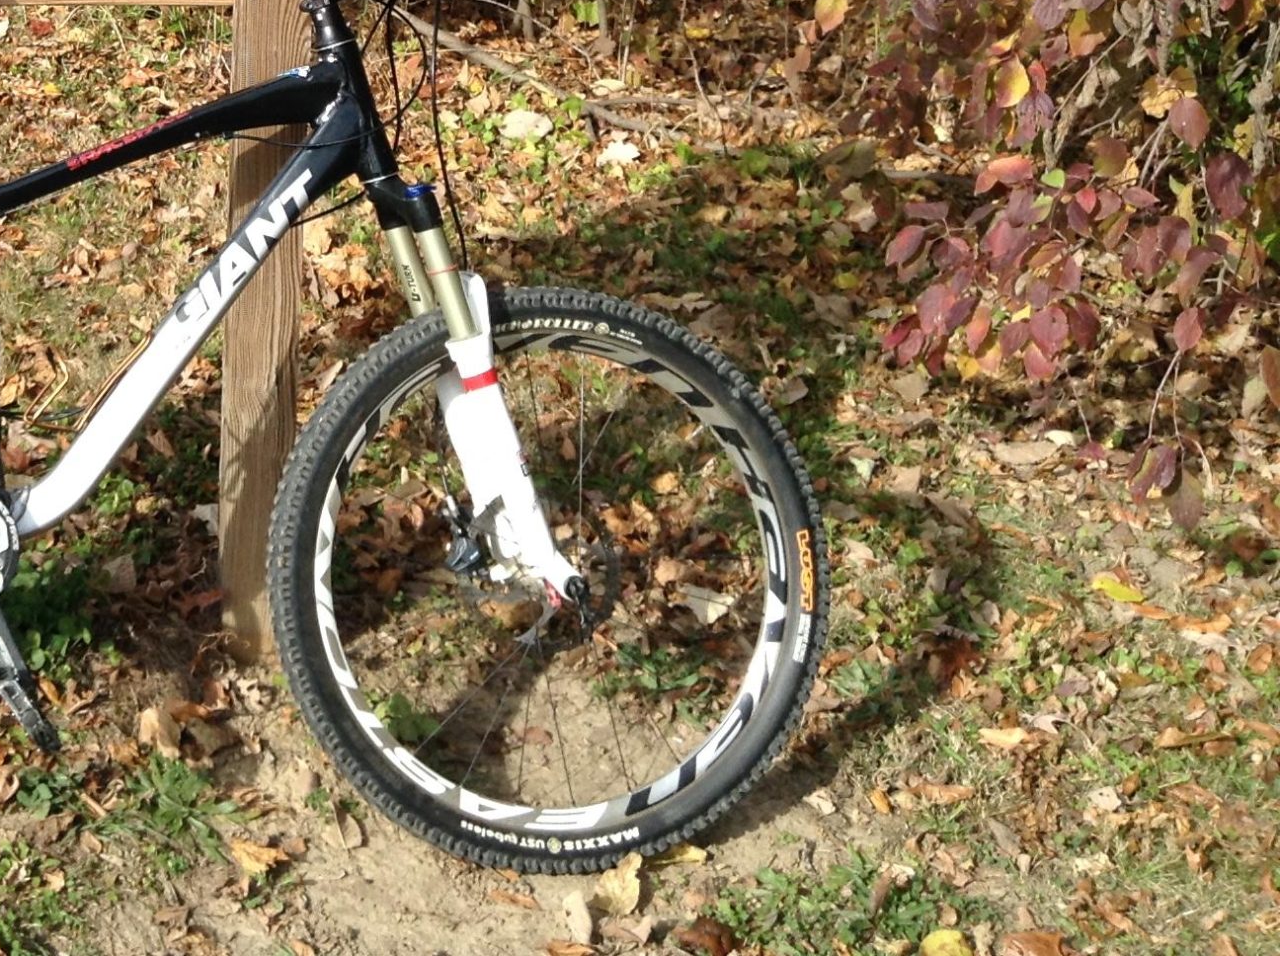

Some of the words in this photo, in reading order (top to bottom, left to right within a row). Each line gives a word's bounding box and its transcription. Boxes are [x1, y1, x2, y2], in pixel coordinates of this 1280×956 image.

[176, 168, 314, 325] GIANT
[403, 264, 422, 303] U-TURN
[795, 528, 813, 610] LUST
[518, 836, 544, 849] UST
[563, 824, 641, 850] MAXXIS
